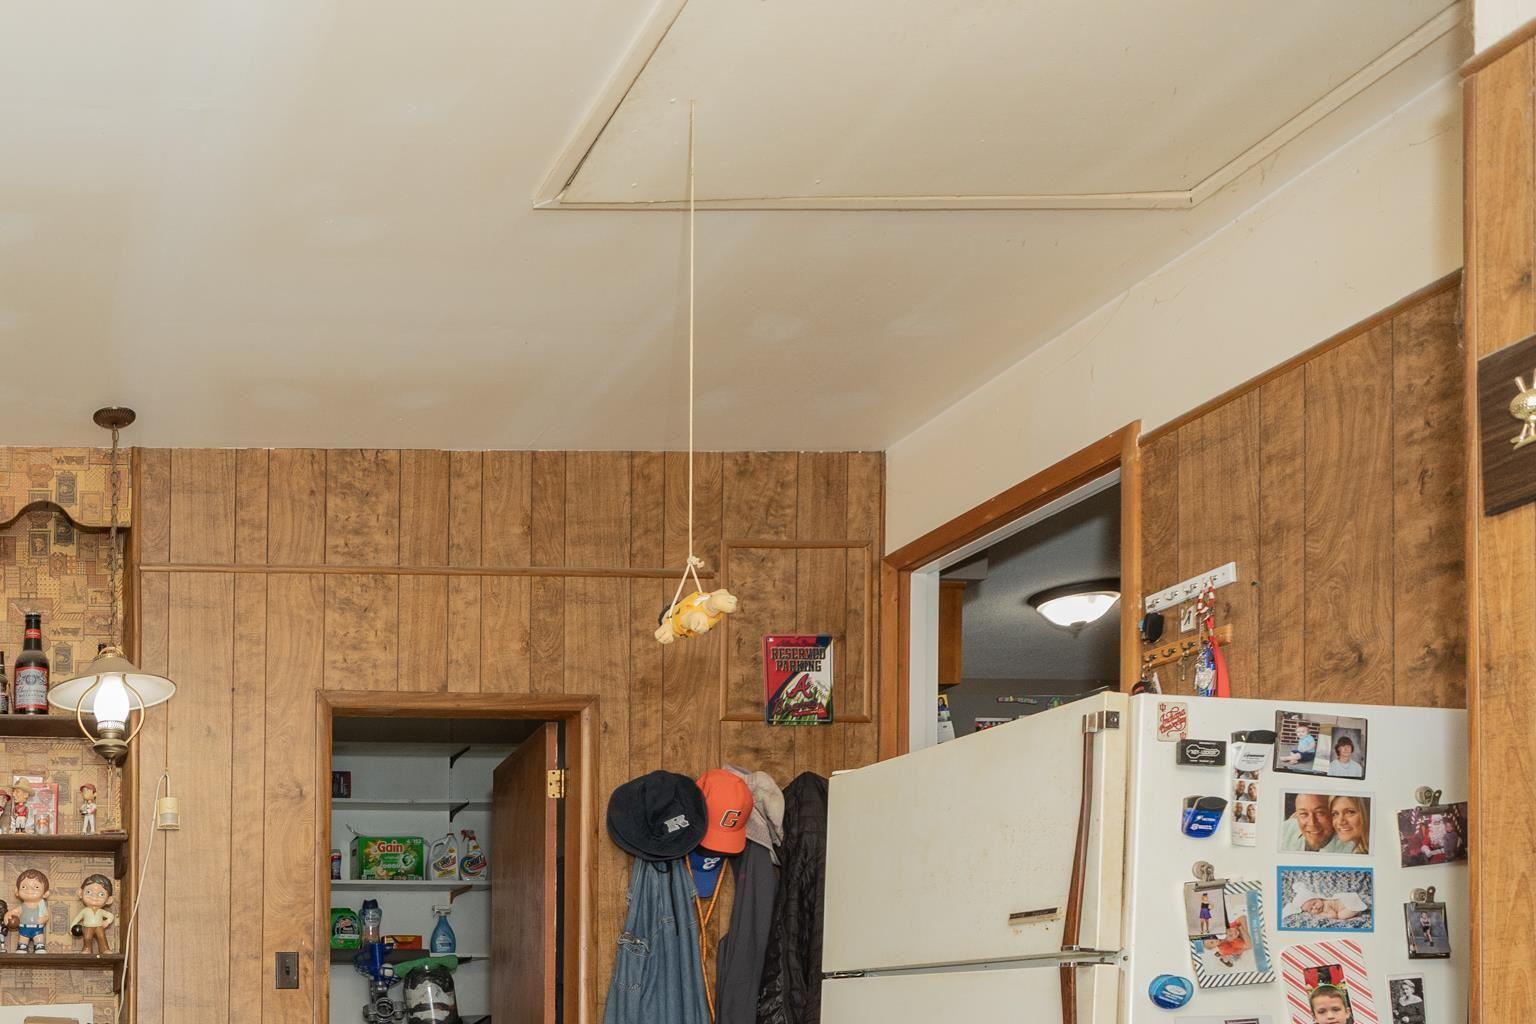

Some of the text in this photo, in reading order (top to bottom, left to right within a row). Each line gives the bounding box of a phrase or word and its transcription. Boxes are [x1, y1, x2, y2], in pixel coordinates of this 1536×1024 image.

[771, 646, 826, 660] RESERVED
[776, 660, 822, 672] PARKING
[720, 808, 742, 828] G
[377, 840, 403, 853] Gain
